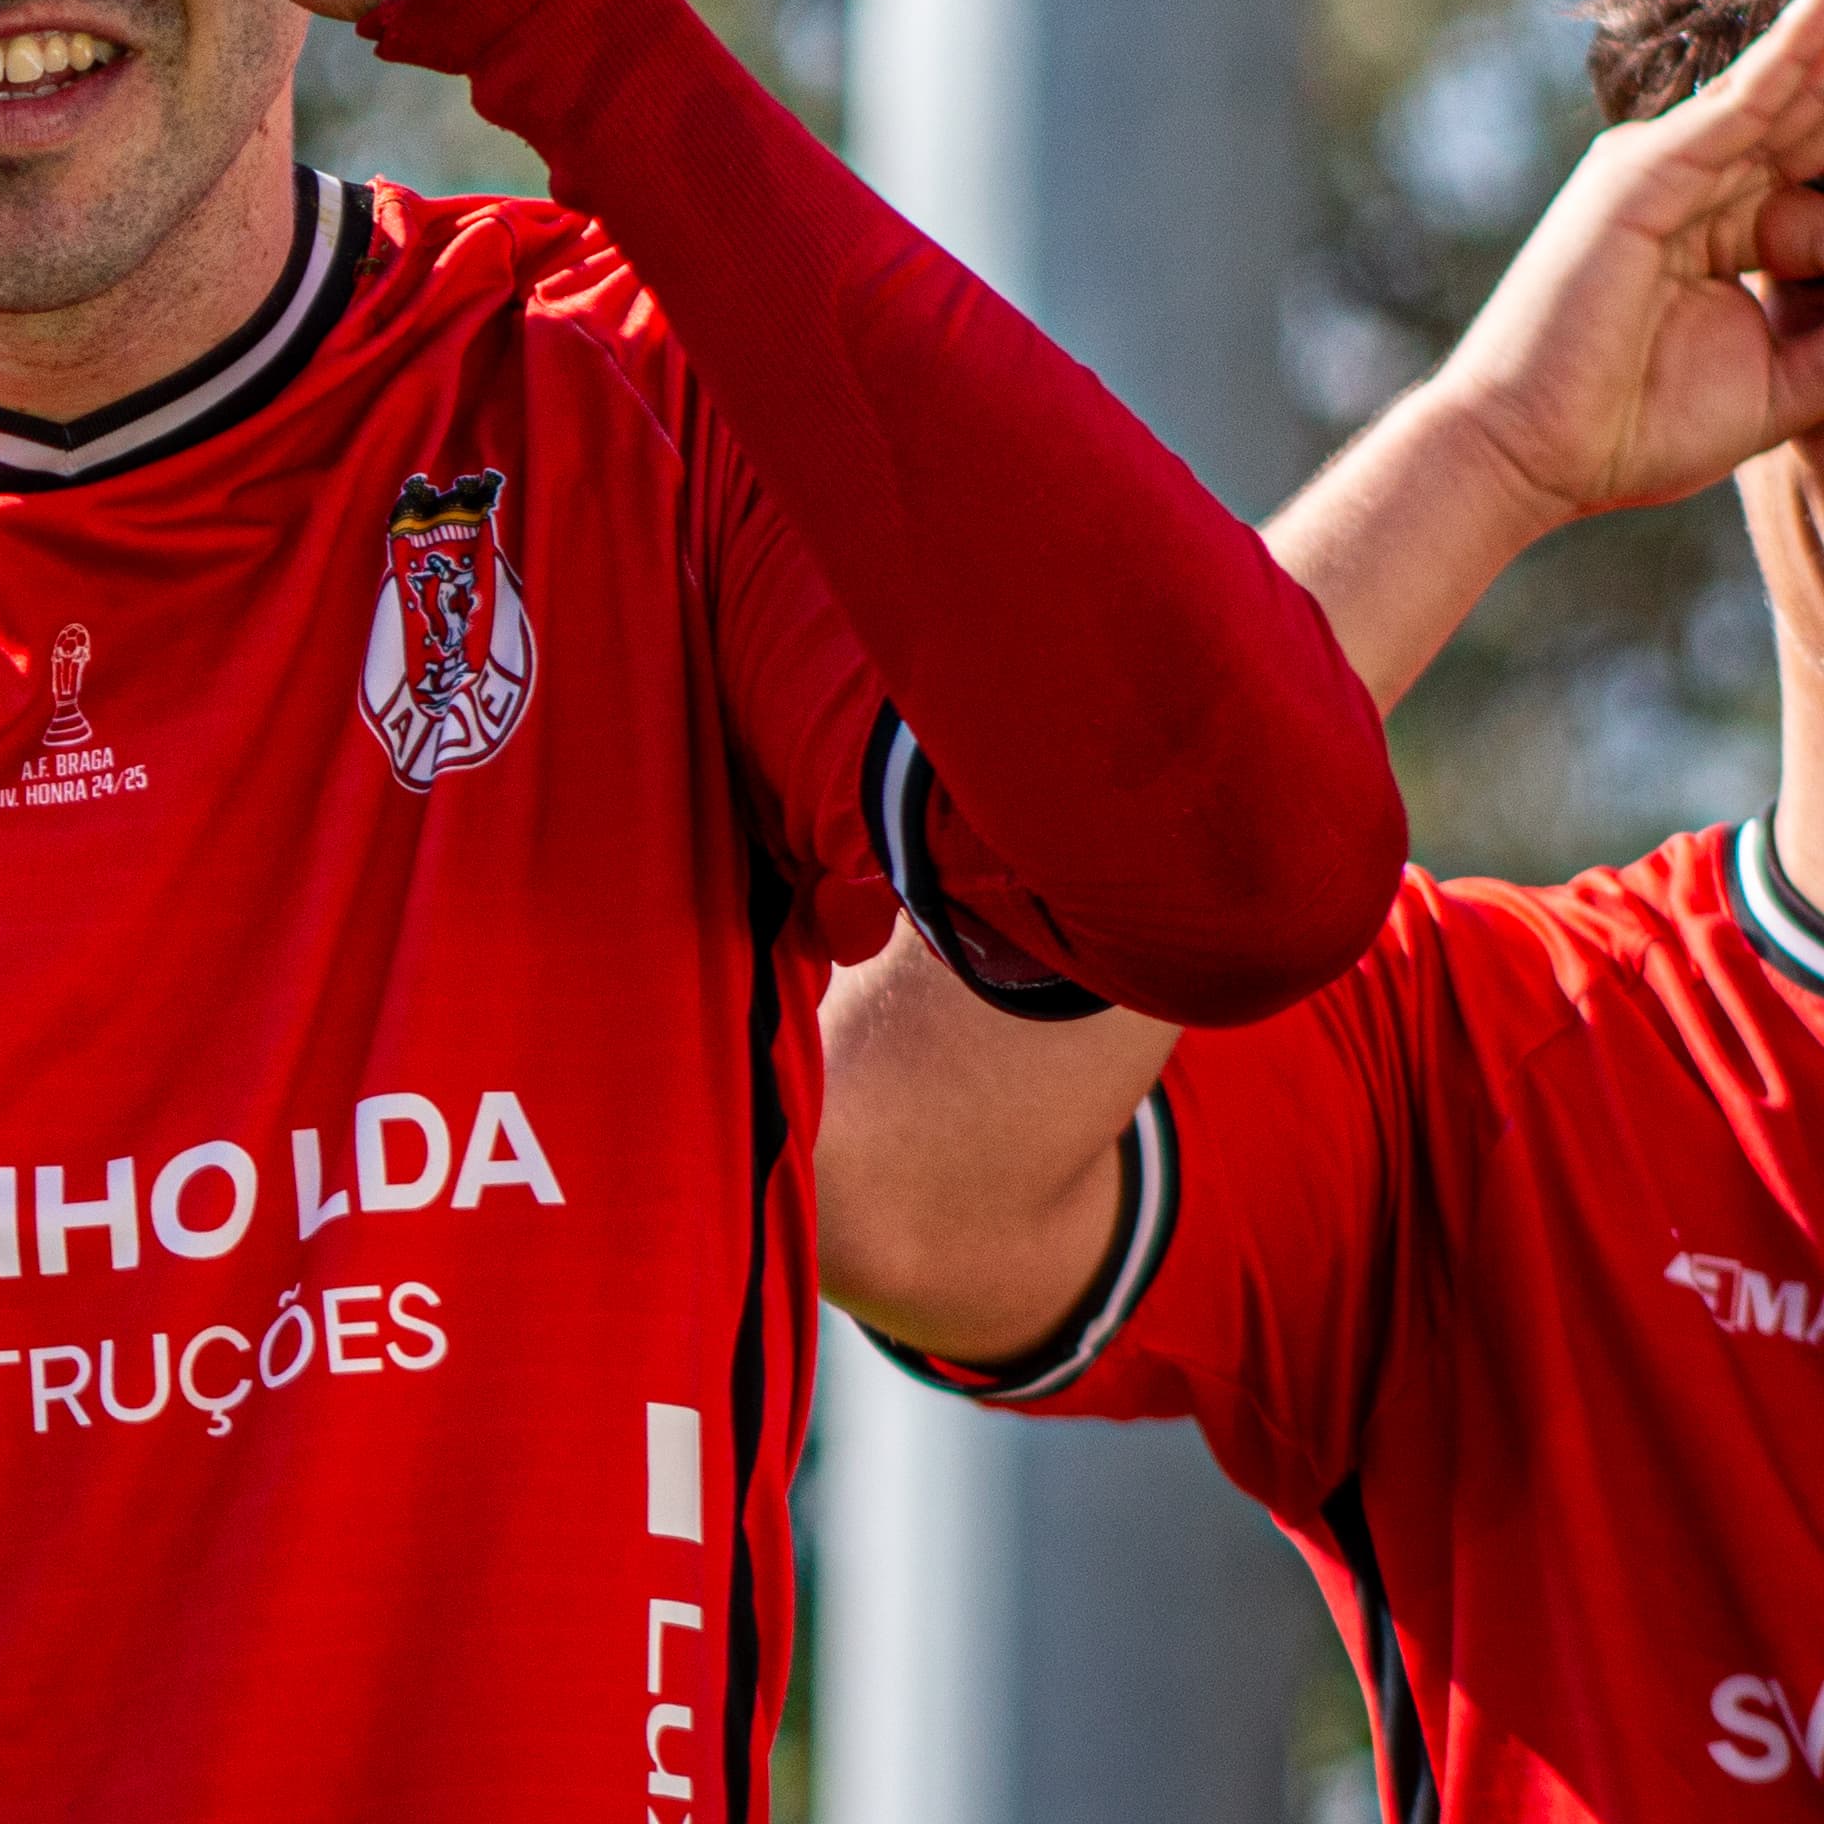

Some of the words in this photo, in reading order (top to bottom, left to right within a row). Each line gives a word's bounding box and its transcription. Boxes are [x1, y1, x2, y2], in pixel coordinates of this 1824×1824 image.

[21, 756, 51, 781] A.F.
[55, 746, 114, 777] BRAGA
[25, 778, 88, 806] HONRA
[91, 764, 149, 798] 24/25
[290, 1091, 567, 1241] LDA
[646, 1597, 704, 1824] Lu
